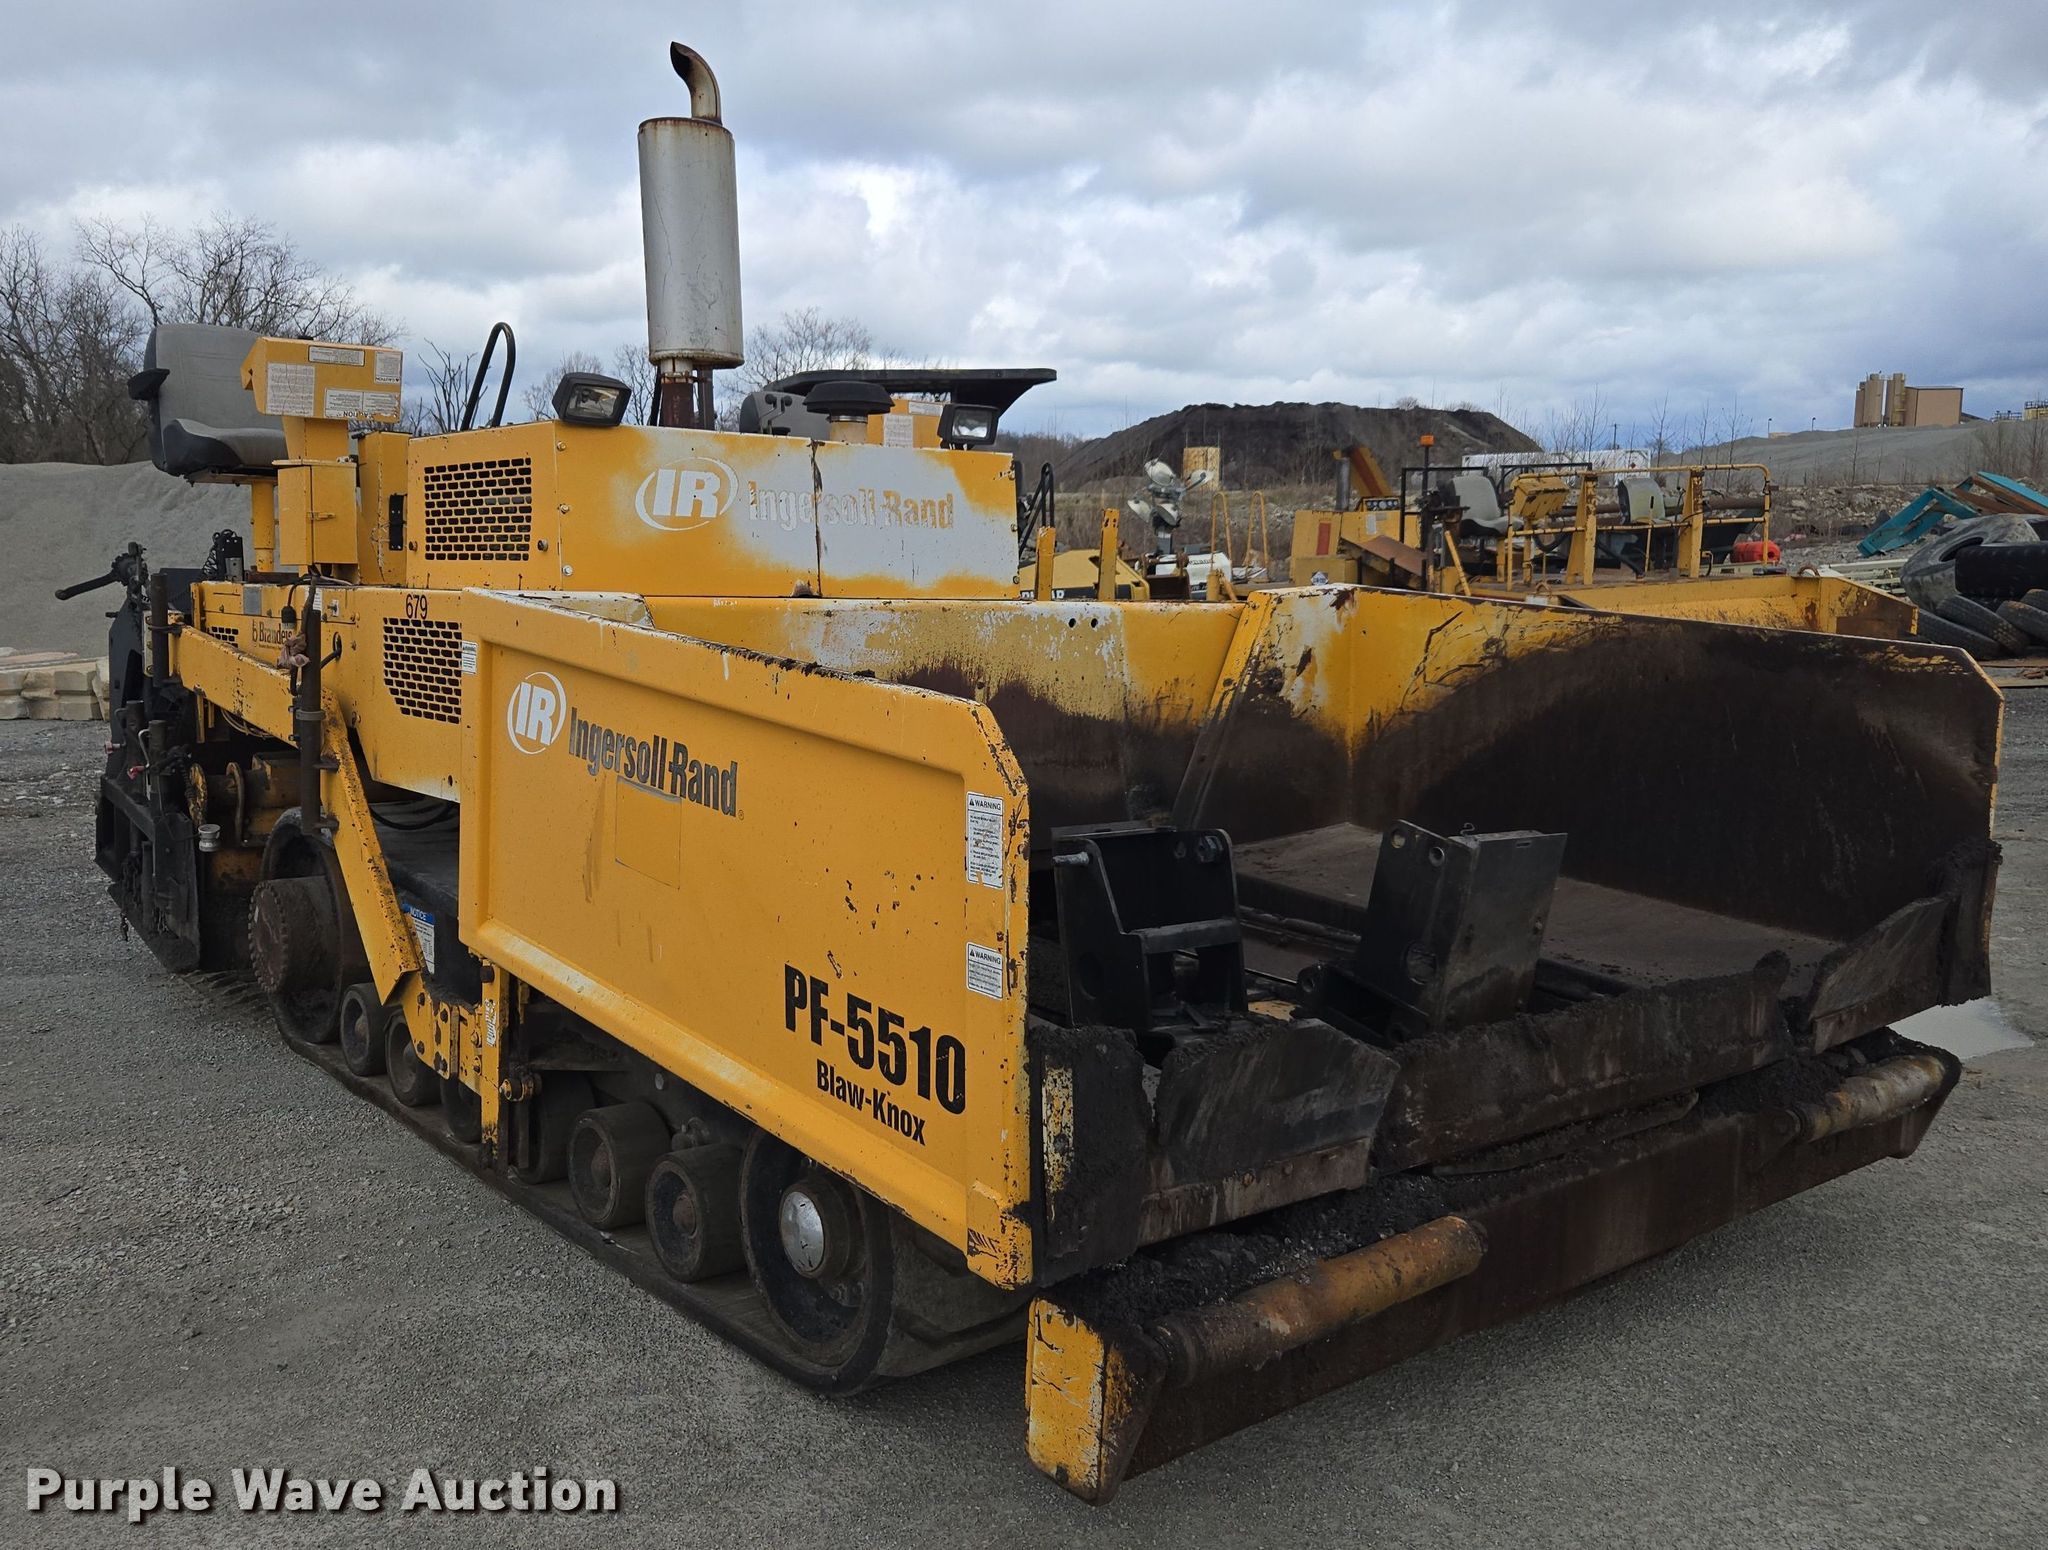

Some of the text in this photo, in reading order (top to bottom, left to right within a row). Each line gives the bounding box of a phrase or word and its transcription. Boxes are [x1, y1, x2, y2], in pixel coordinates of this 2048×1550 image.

[652, 467, 721, 518] IR
[748, 481, 954, 531] Ingersoll-Rand
[405, 593, 428, 620] 679
[514, 680, 558, 747] IR
[568, 706, 739, 818] Ingersoll-Rand
[975, 799, 1001, 811] WARNING
[976, 952, 1001, 965] WARNING
[785, 963, 966, 1115] PF-5510
[816, 1058, 926, 1146] Blaw-Knox
